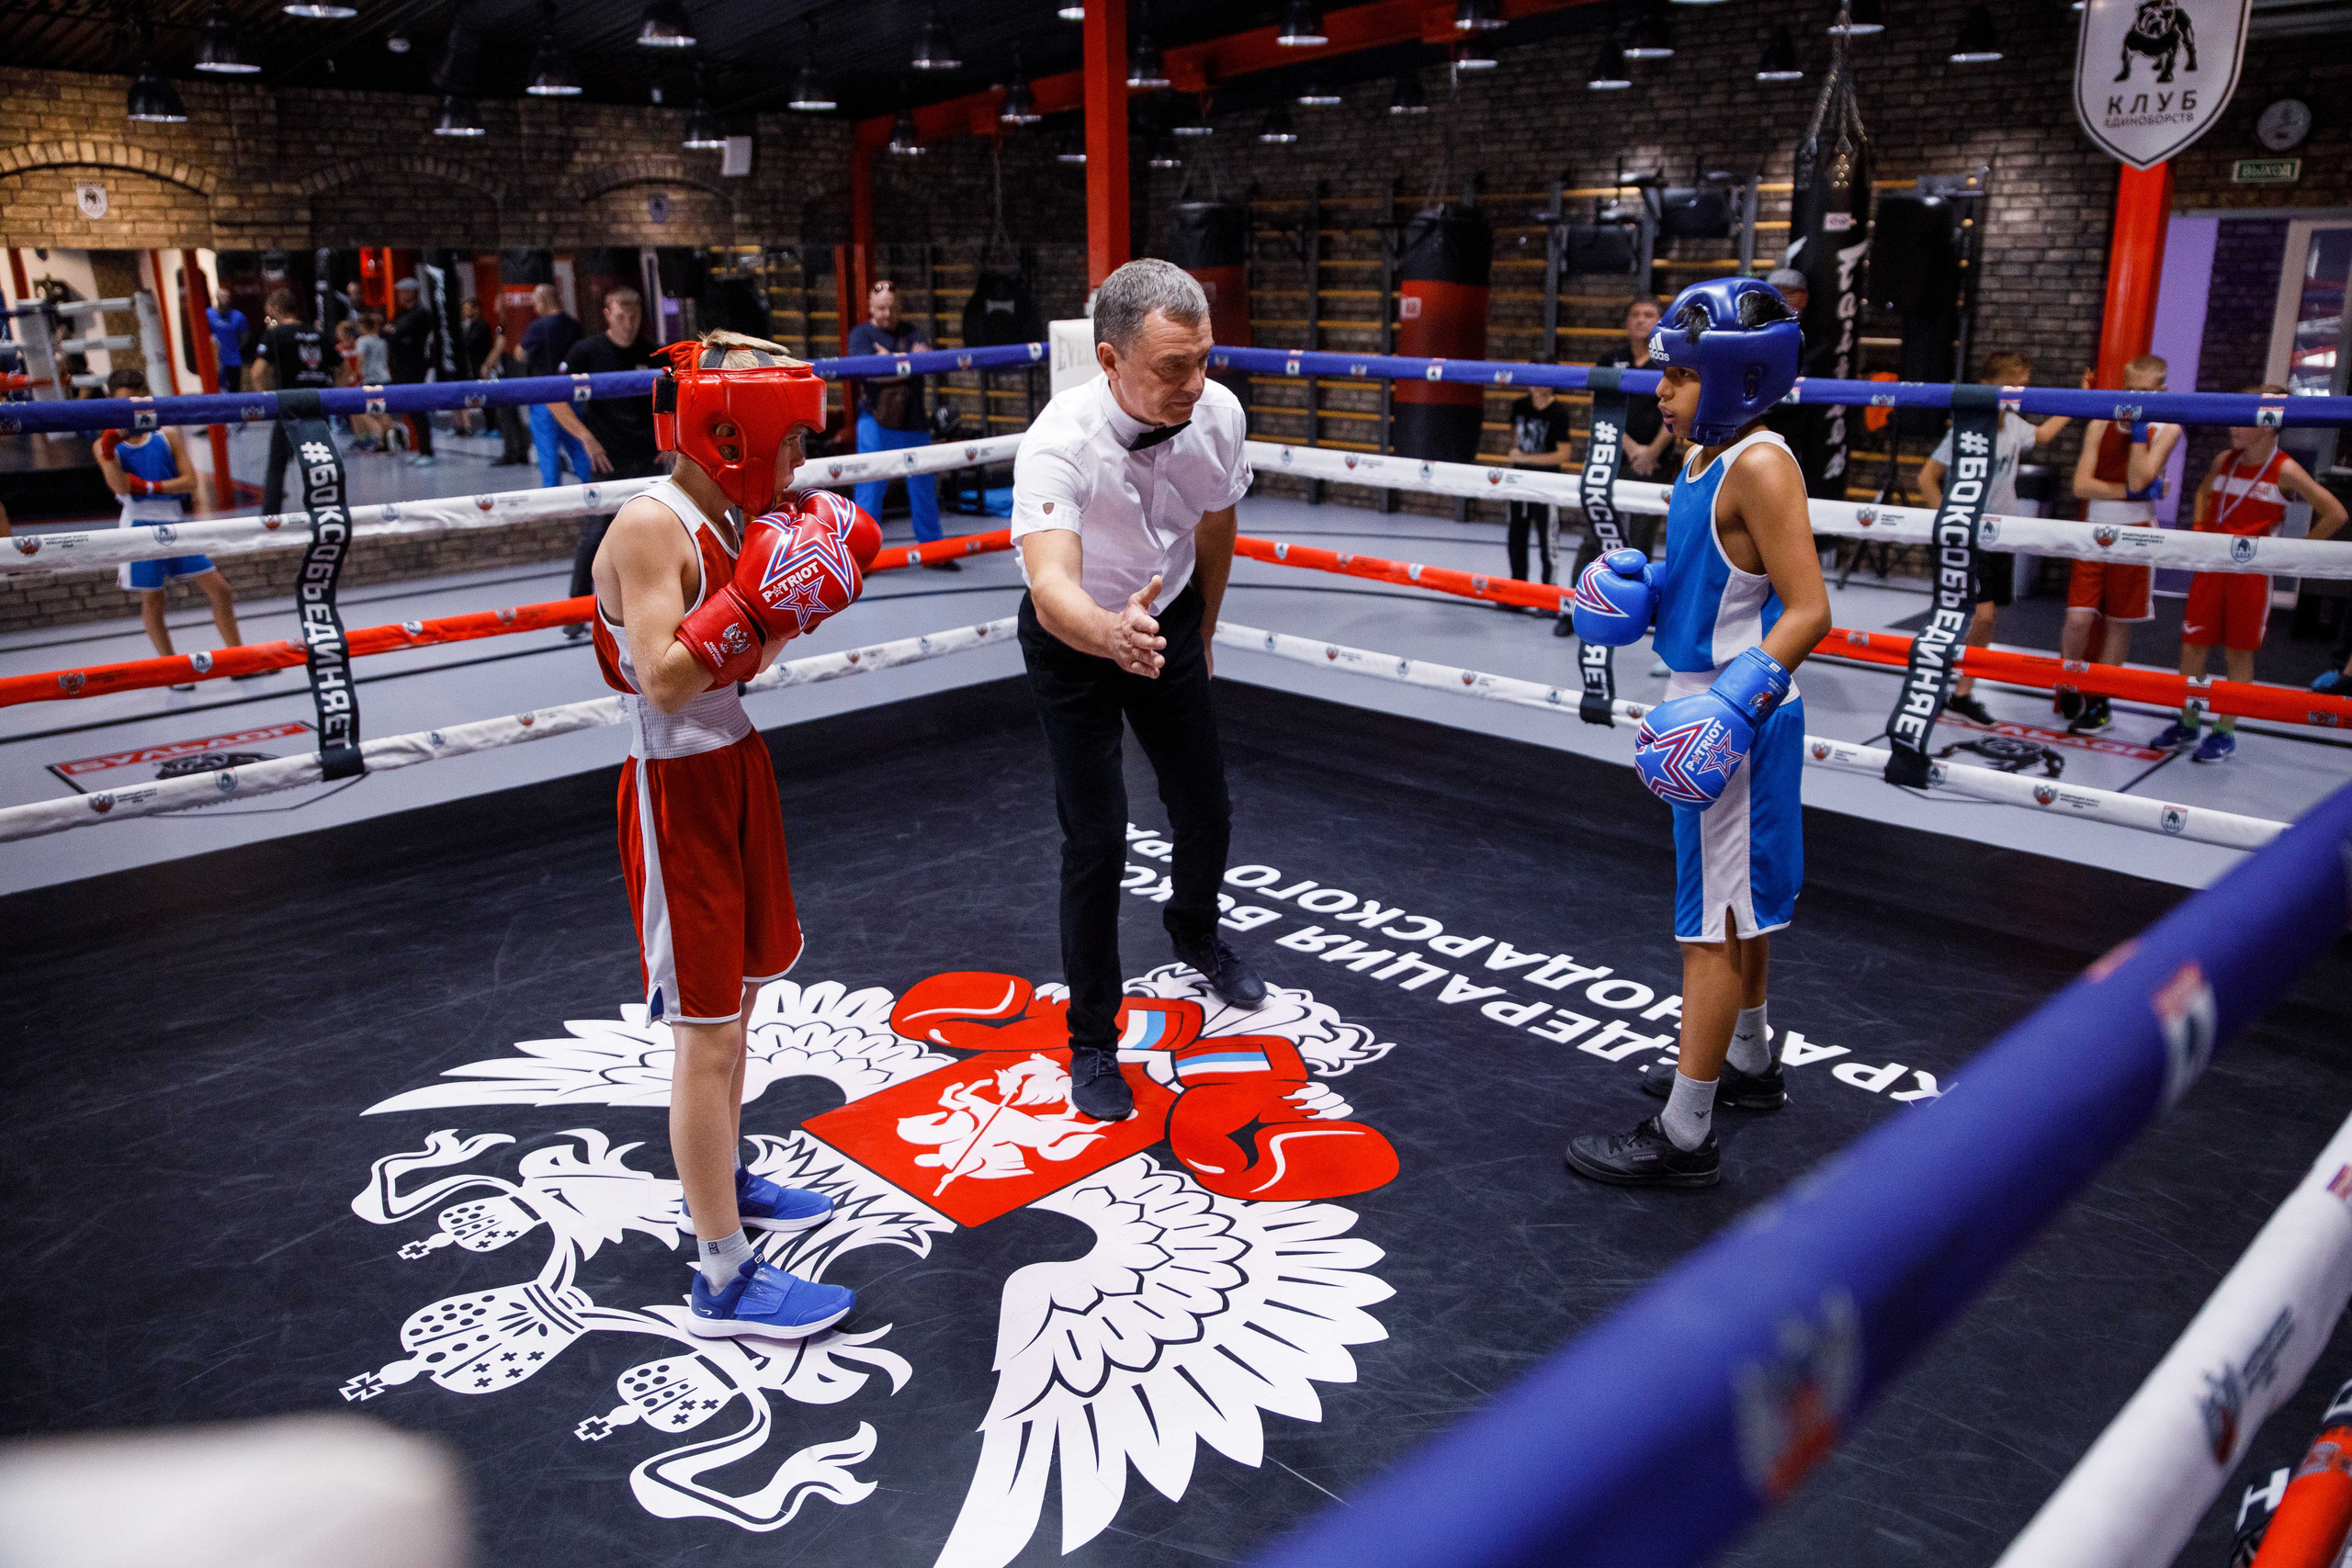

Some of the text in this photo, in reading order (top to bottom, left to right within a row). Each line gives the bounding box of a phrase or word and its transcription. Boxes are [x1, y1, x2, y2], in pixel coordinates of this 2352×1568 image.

[2108, 90, 2198, 115] КЛУБ
[2105, 112, 2195, 129] ЕДИНОБОРСТВ
[2243, 163, 2293, 178] ВЫХОД
[300, 441, 353, 750] #БОКСОБЪЕДИНЯЕТ
[1274, 925, 1733, 1106] ДЕРАЦИЯ
